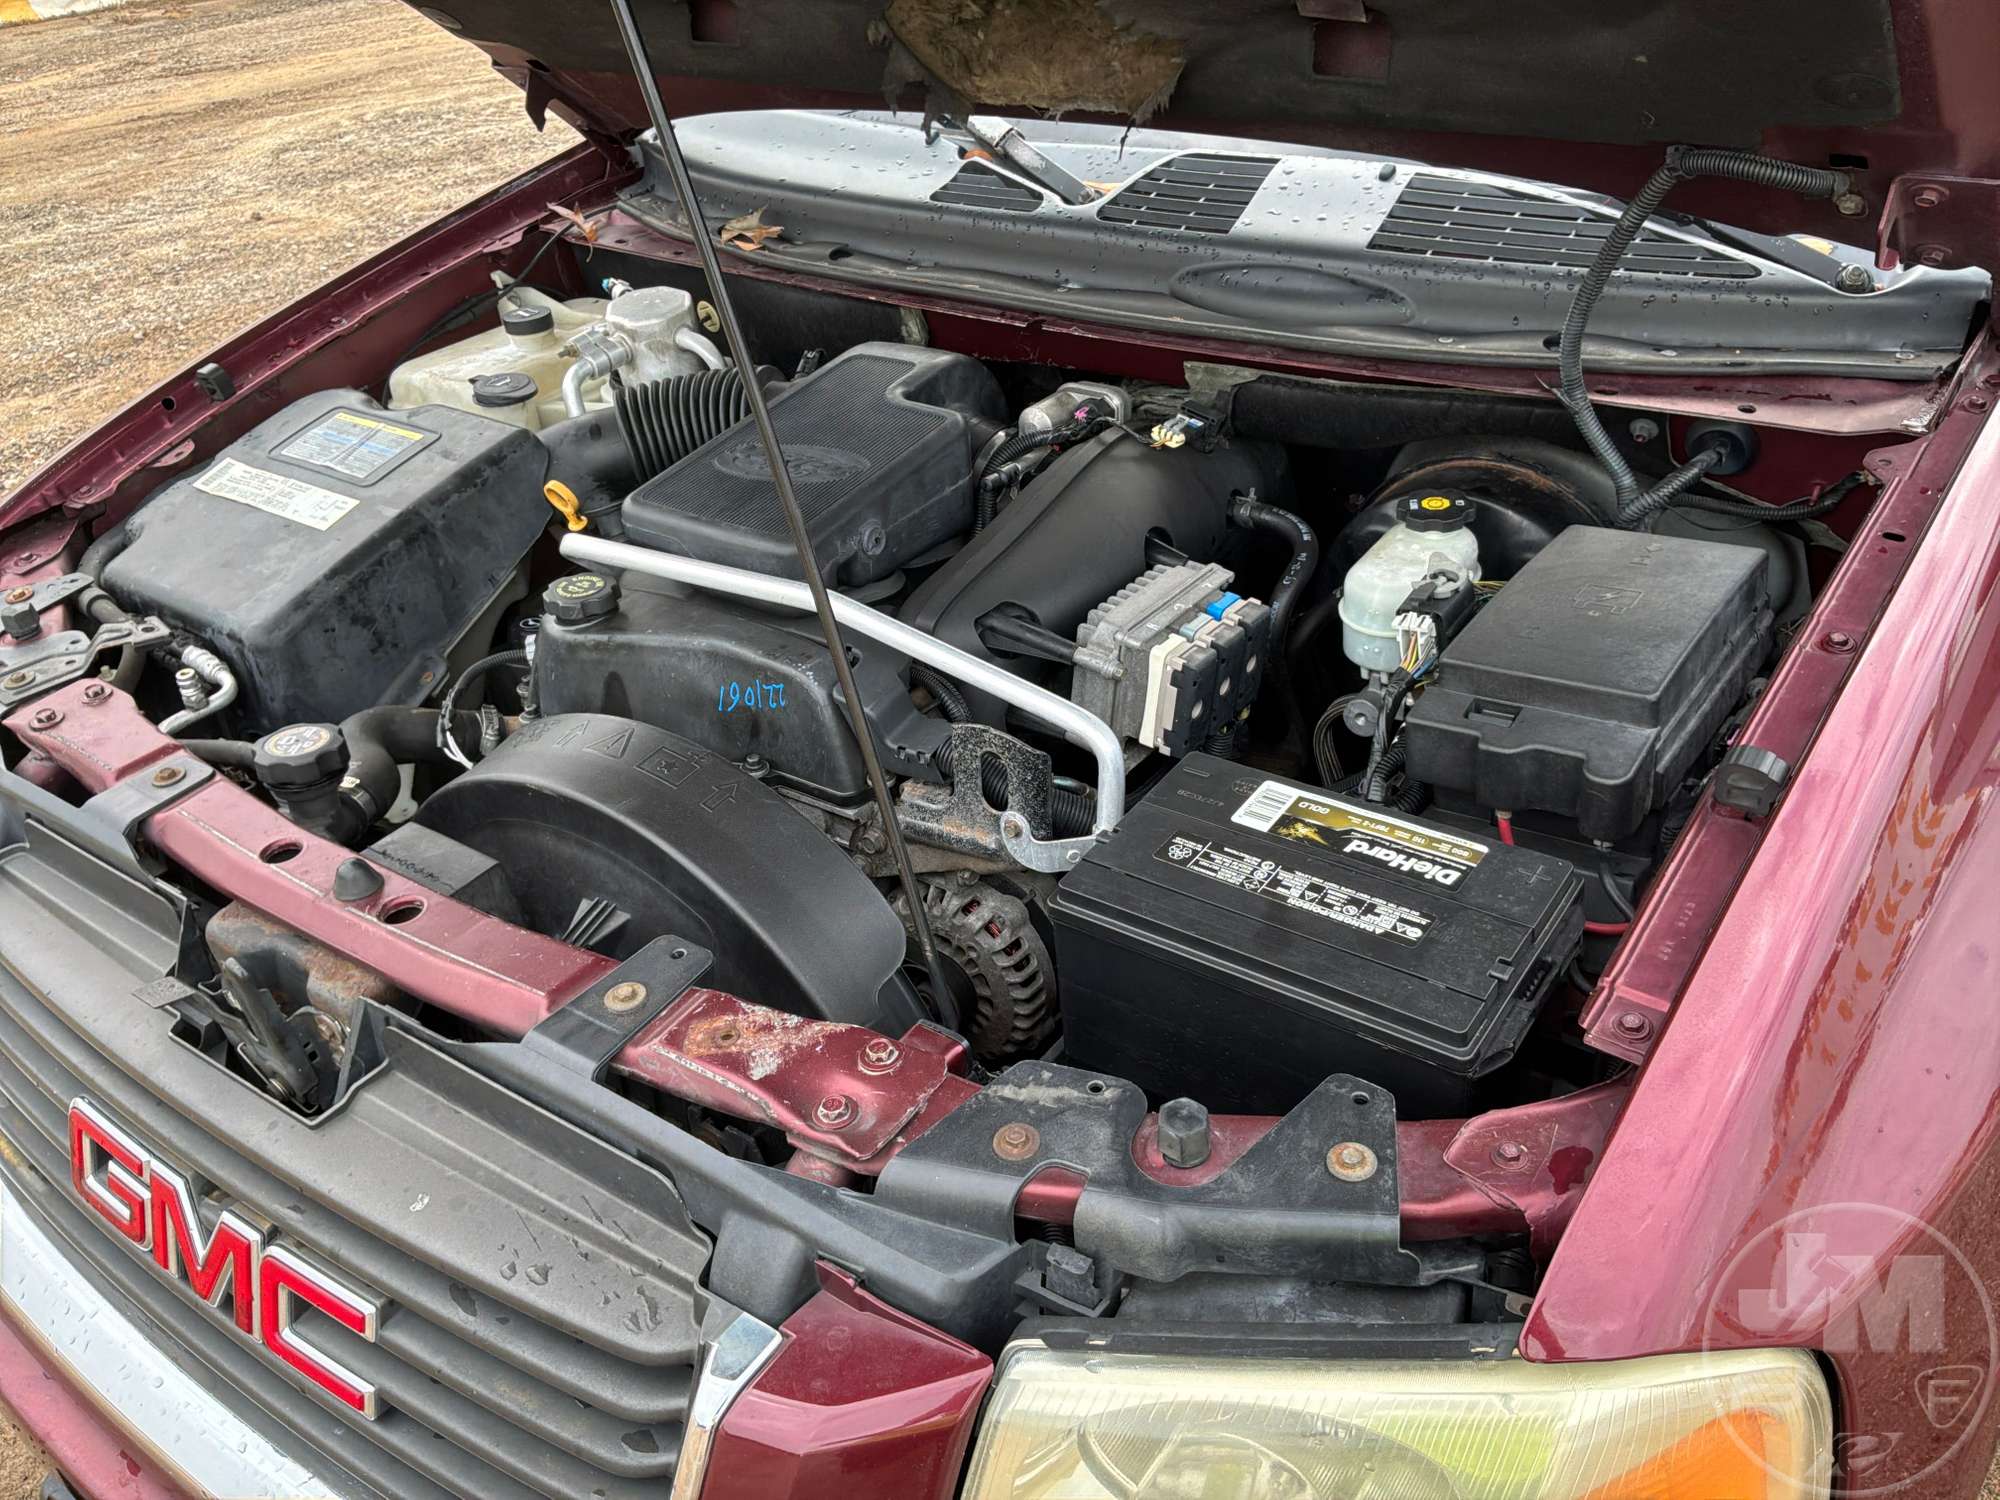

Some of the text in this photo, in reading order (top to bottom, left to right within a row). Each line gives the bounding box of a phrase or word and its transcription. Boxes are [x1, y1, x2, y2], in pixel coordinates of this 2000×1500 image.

[1298, 801, 1331, 815] GOLD
[1343, 840, 1462, 886] DieHard
[1287, 896, 1375, 932] DANGER/POISON
[69, 1095, 378, 1421] GMC
